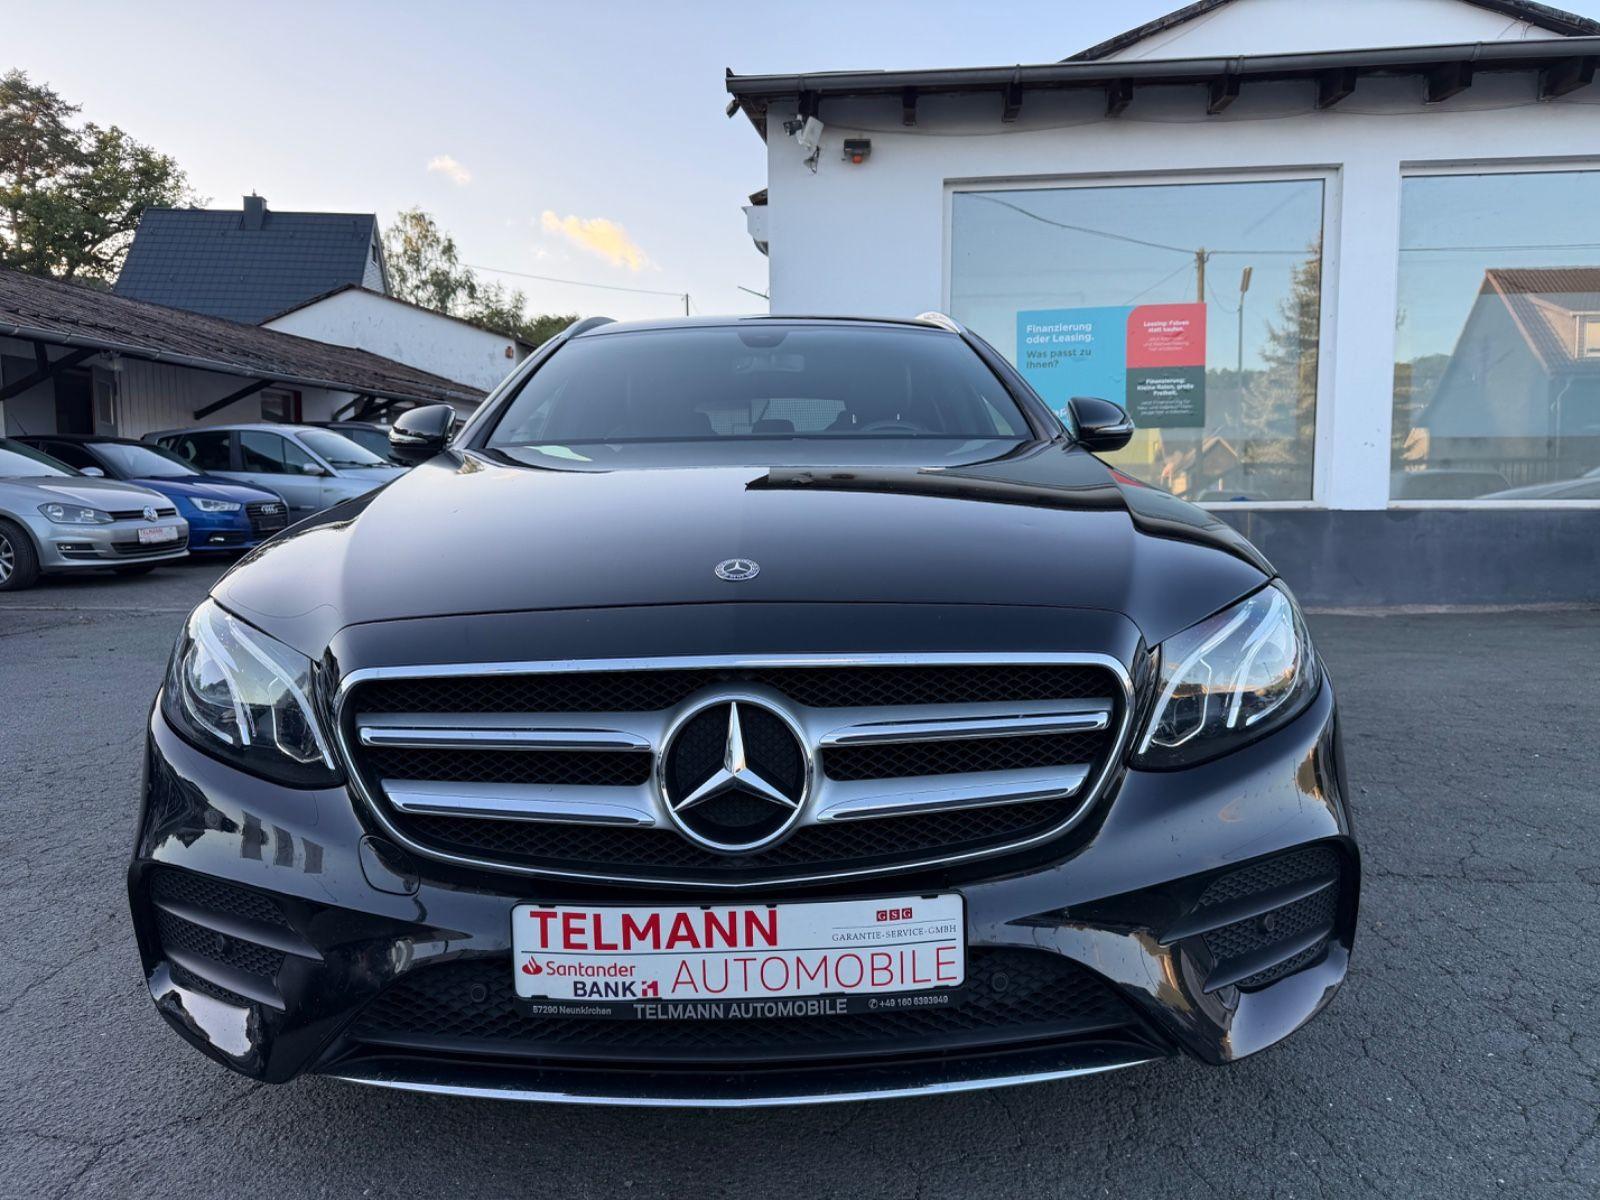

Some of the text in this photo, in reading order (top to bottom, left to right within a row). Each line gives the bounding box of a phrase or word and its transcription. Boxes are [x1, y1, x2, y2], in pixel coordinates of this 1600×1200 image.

[1026, 323, 1092, 333] Finanzierung
[1026, 333, 1095, 344] oder Leasing.
[1026, 348, 1092, 359] Was passt zu
[1026, 360, 1060, 369] Ihnen?
[876, 907, 913, 922] GSG
[529, 909, 778, 951] TELMANN
[546, 961, 636, 977] Santander
[671, 946, 958, 994] AUTOMOBILE
[879, 998, 896, 1008] +49
[559, 1005, 612, 1015] Neunkirchen
[633, 998, 848, 1020] TELMANN AUTOMOBILE
